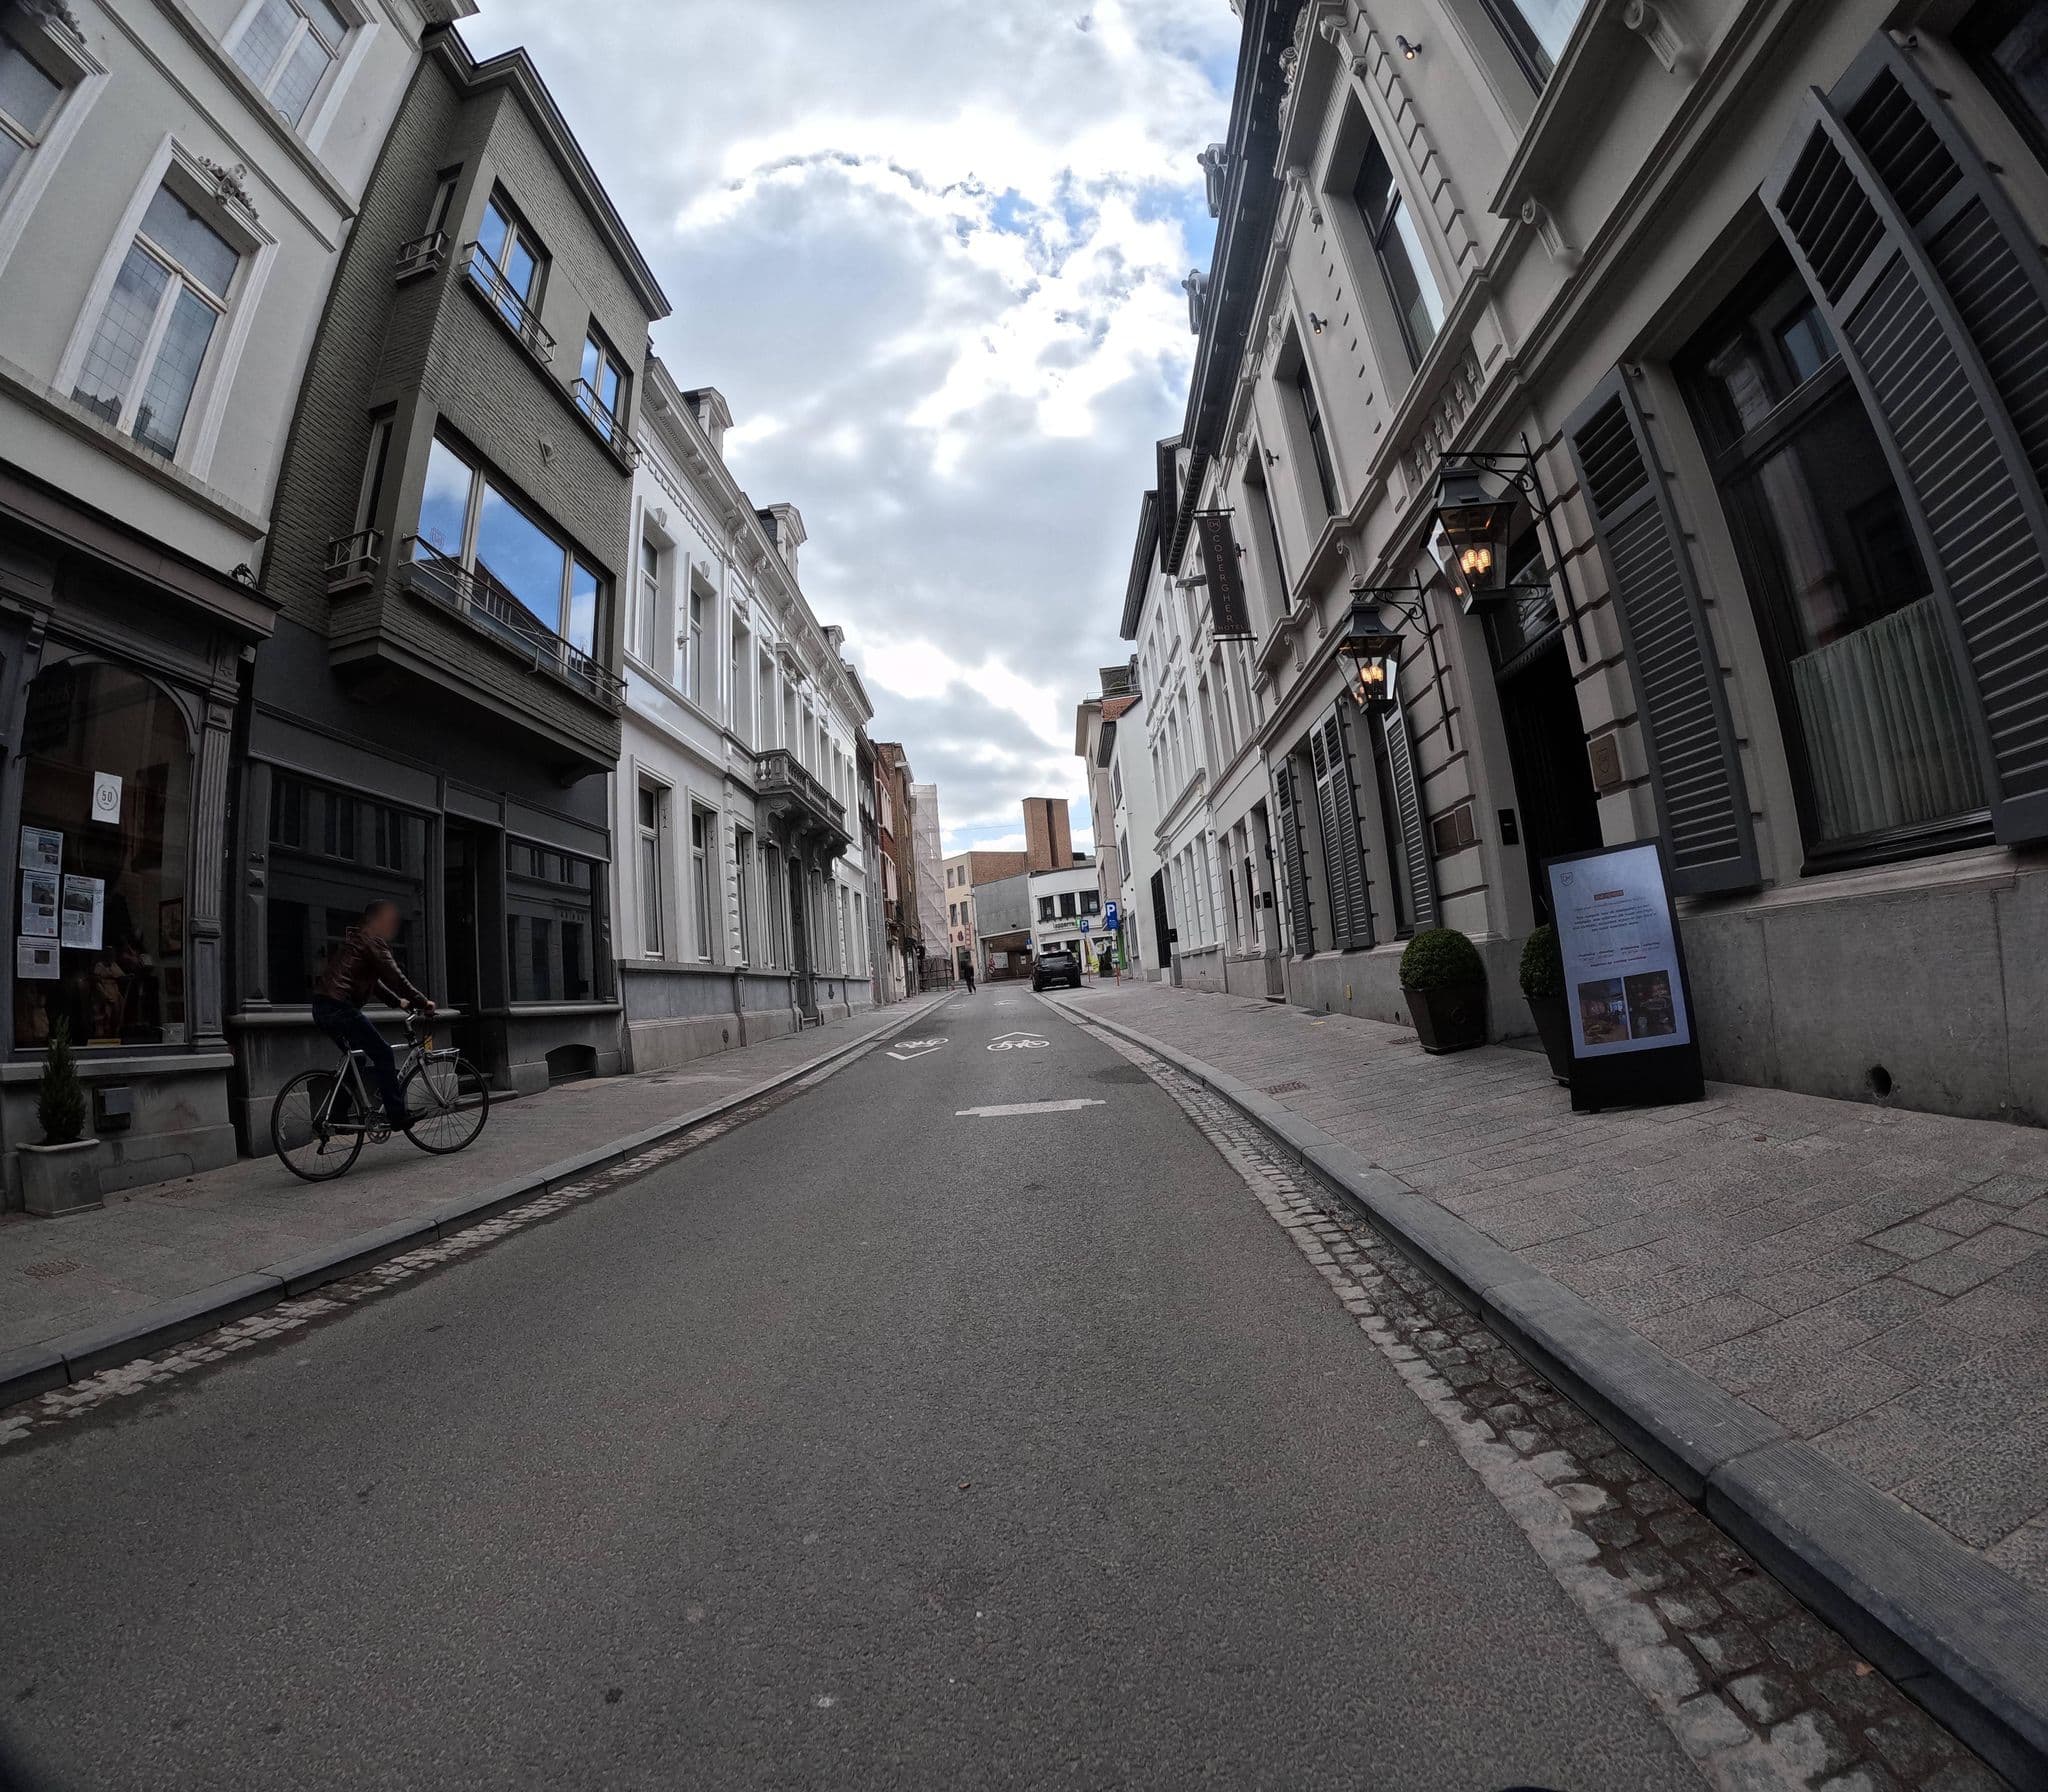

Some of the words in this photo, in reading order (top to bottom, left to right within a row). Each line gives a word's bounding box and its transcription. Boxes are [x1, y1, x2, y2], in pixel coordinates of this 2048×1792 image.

[1212, 534, 1234, 622] COBERGHER
[102, 791, 112, 803] 50
[1106, 904, 1115, 916] P
[1081, 921, 1088, 931] P
